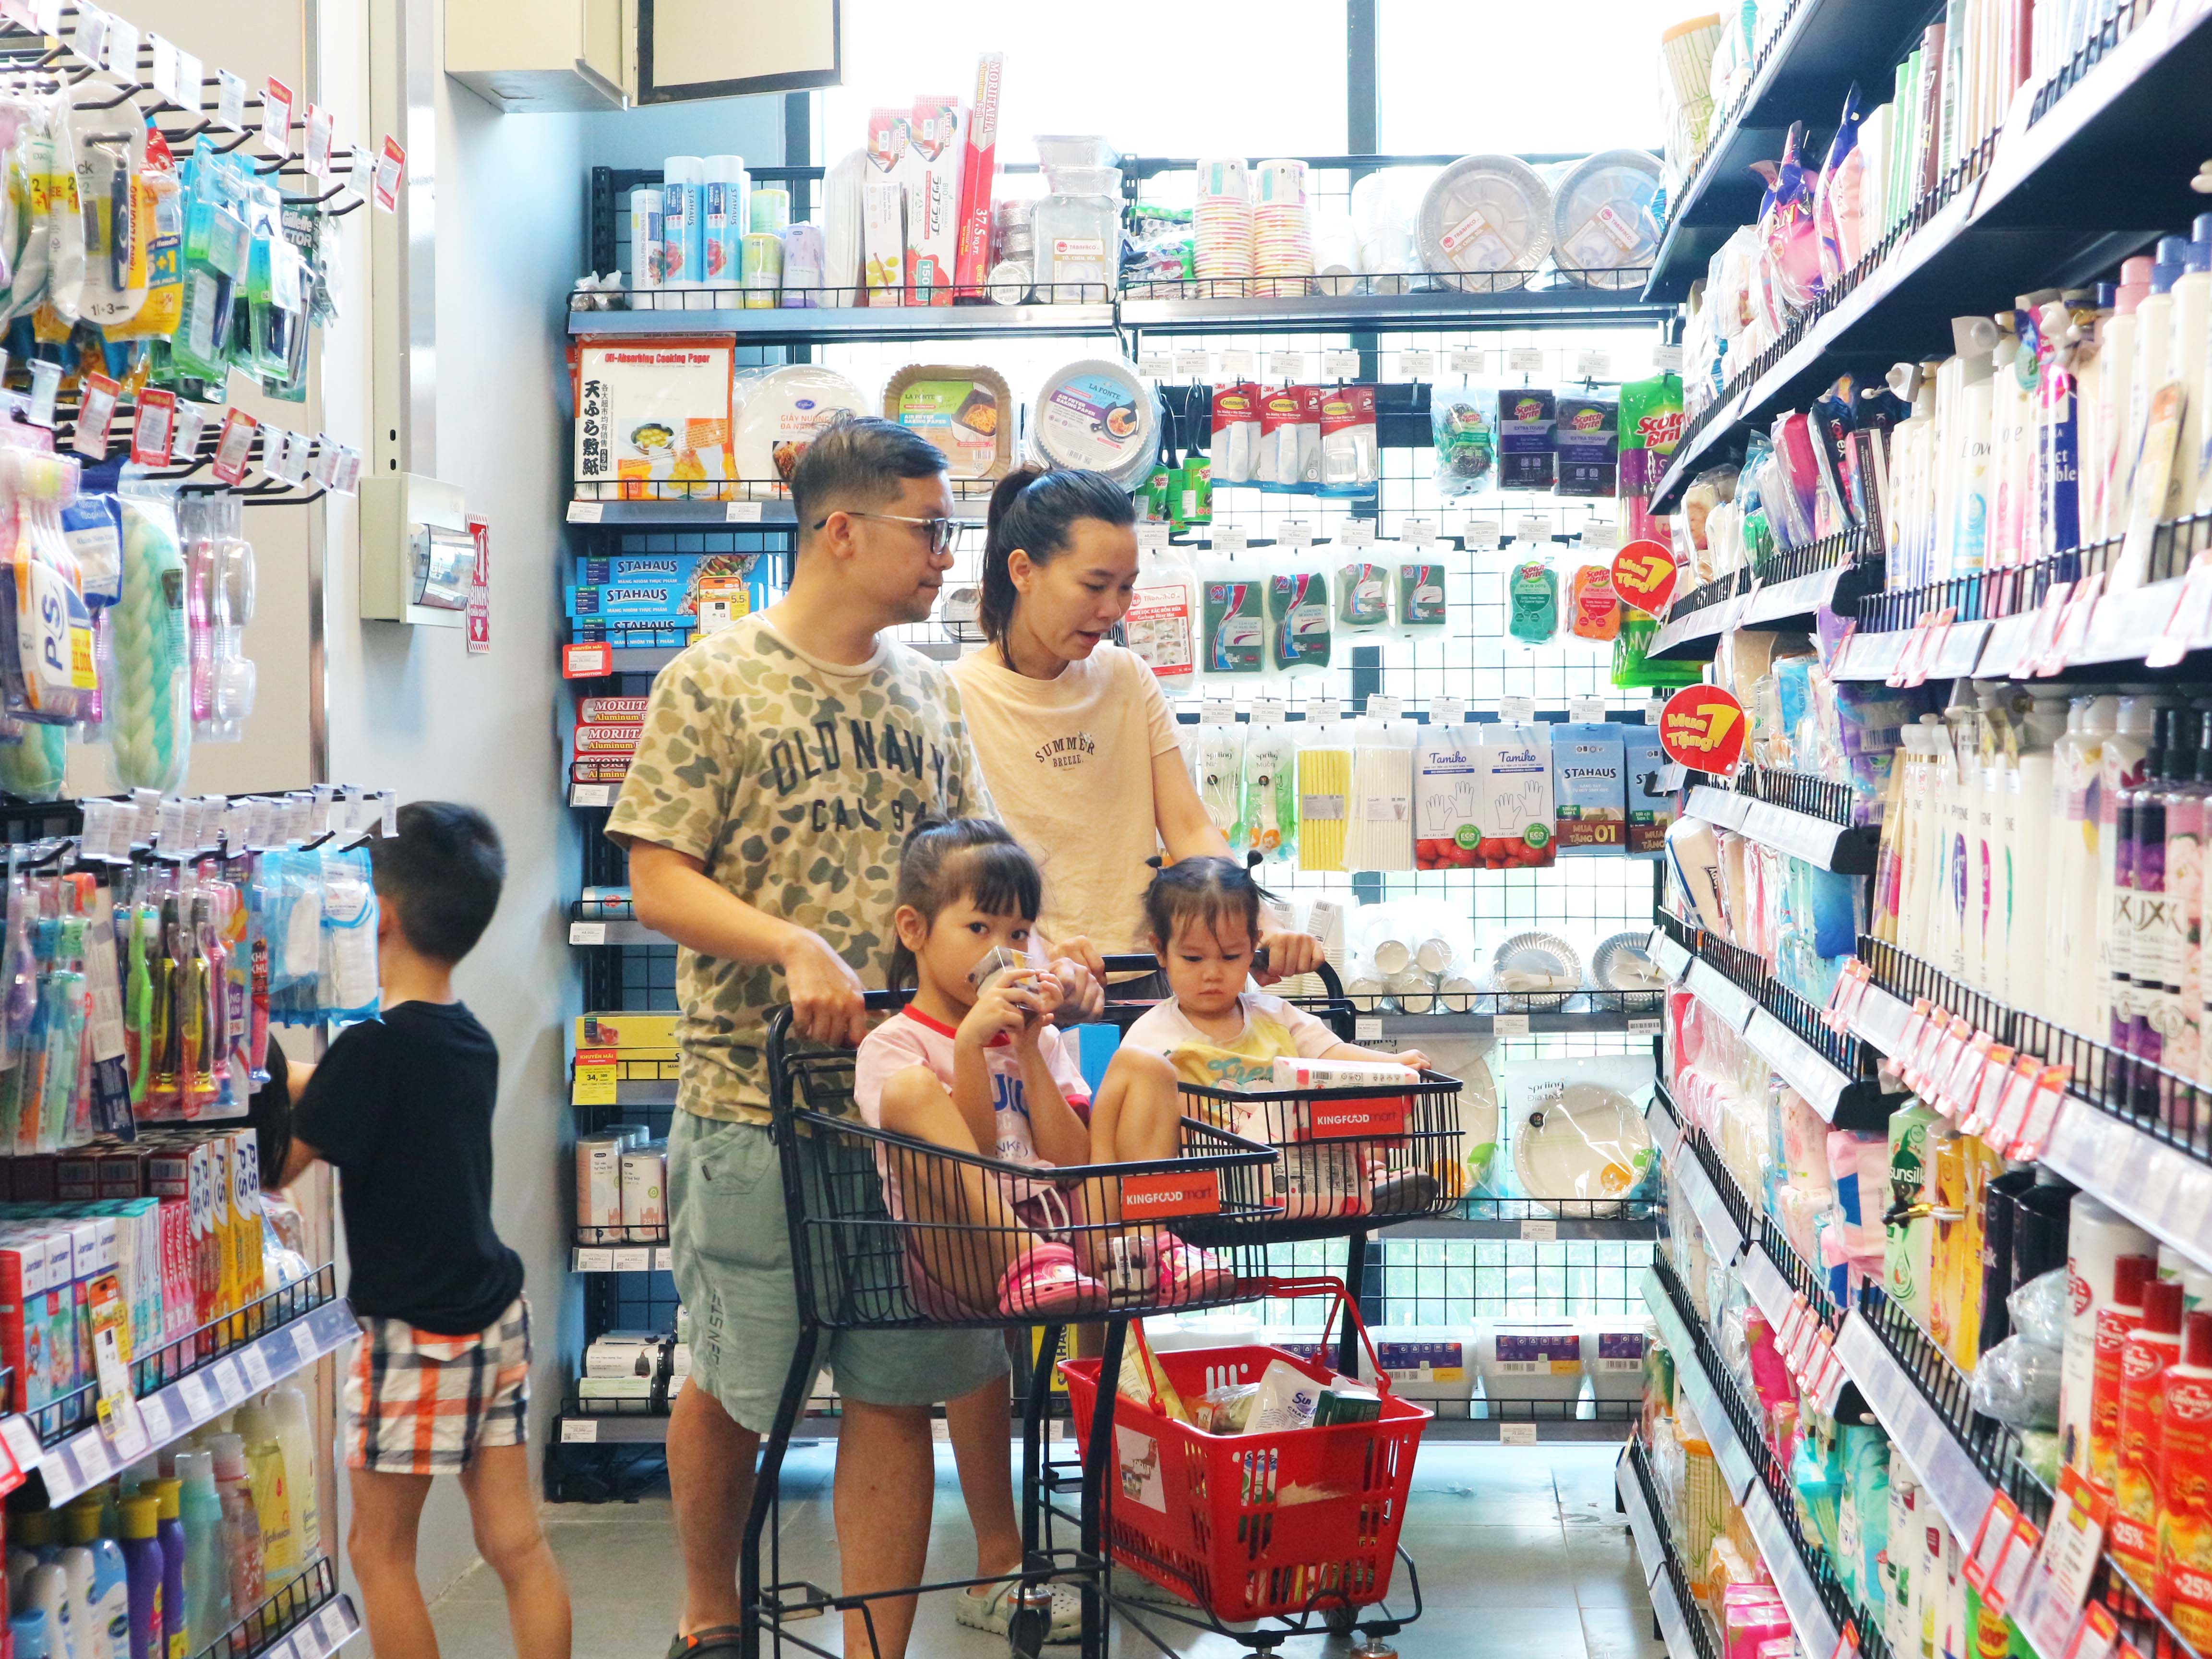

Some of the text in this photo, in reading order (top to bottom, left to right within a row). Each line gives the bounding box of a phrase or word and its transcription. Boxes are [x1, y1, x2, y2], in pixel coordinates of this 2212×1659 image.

[283, 210, 313, 232] Gillette
[688, 353, 710, 363] Paper
[1089, 383, 1121, 400] LA FONTE
[1077, 407, 1096, 417] PAPER
[1518, 409, 1540, 421] Brite
[1576, 420, 1600, 431] Brite
[1645, 430, 1681, 449] Brit
[617, 560, 677, 573] STAHAUS
[606, 589, 668, 602] STAHAUS
[613, 620, 675, 634] STAHAUS
[594, 713, 639, 721] Aluminum
[1667, 713, 1707, 732] Mua
[588, 741, 634, 750] Aluminum
[1666, 731, 1714, 753] Tặng
[1035, 736, 1094, 763] SUMMER
[1498, 749, 1536, 762] Tamiko
[770, 720, 945, 796] OLD NAVY
[1429, 750, 1467, 764] Tamiko
[1564, 768, 1617, 779] STAHAUS
[1569, 833, 1593, 844] TẶNG
[1573, 824, 1616, 842] MUA 01
[1645, 830, 1664, 839] MUA
